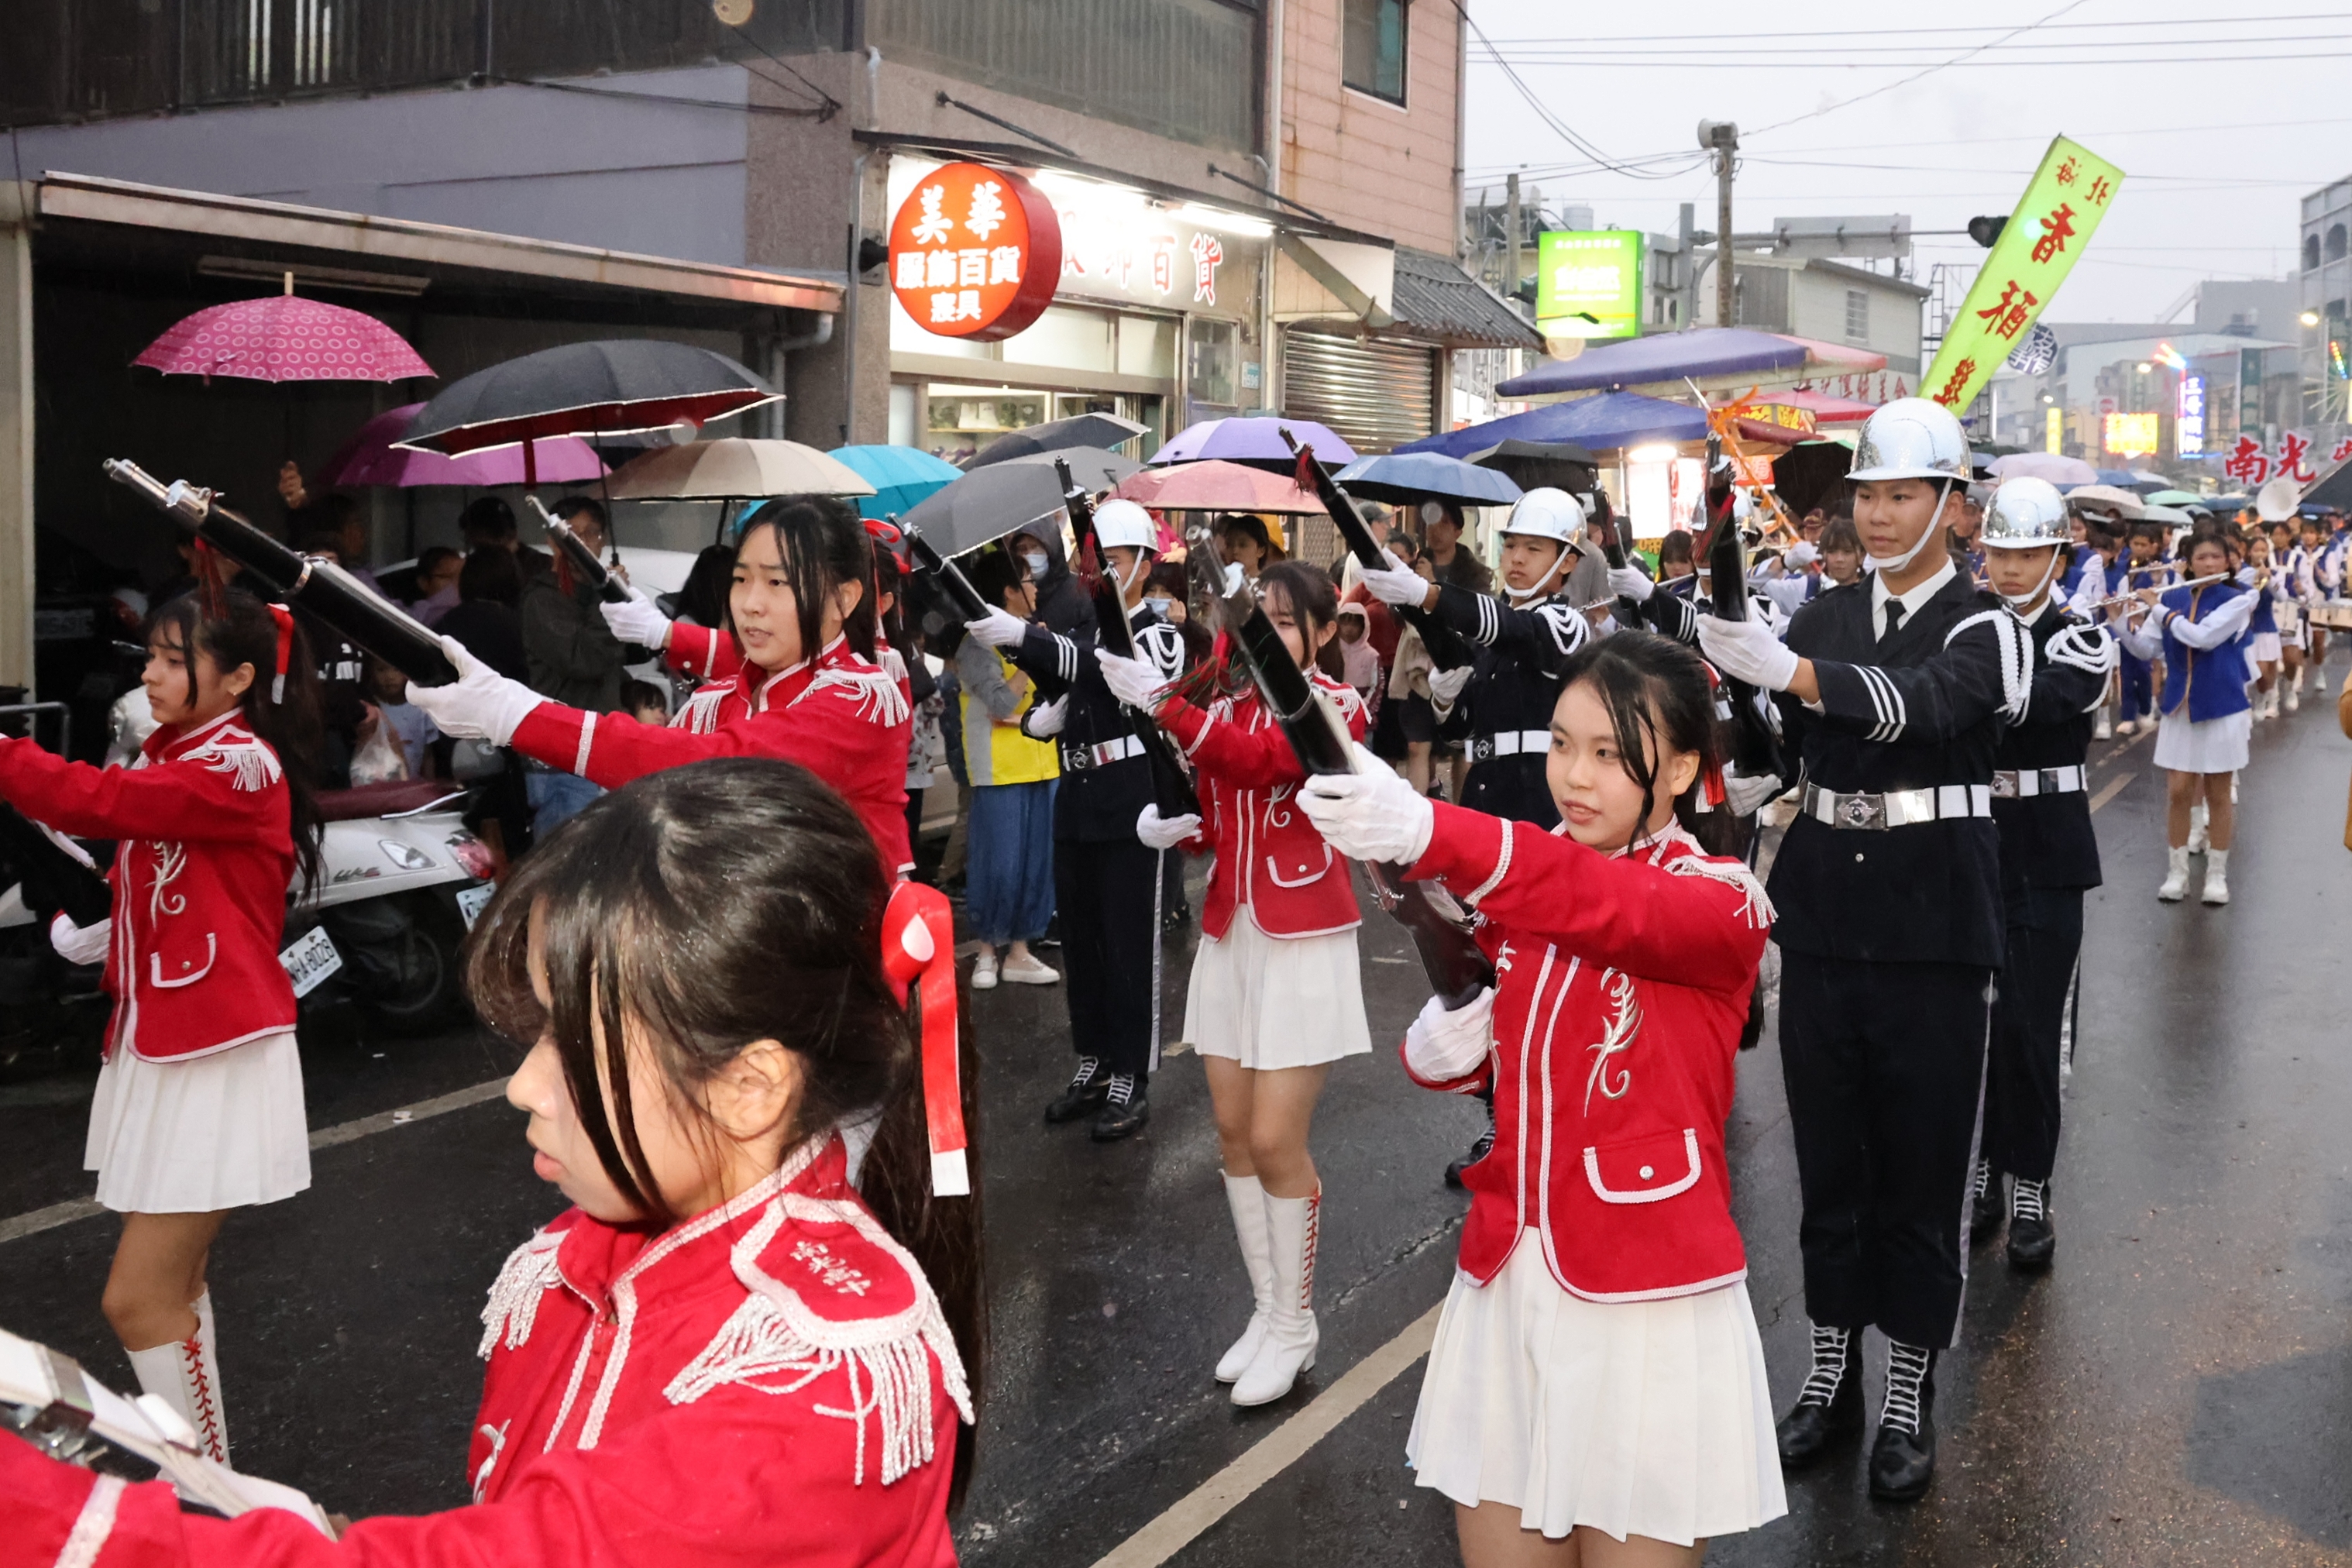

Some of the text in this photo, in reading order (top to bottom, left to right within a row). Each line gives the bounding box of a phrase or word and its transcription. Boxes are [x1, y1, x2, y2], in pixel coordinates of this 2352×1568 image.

[911, 181, 1007, 245] 美華
[896, 245, 1022, 290] 服飾百貨
